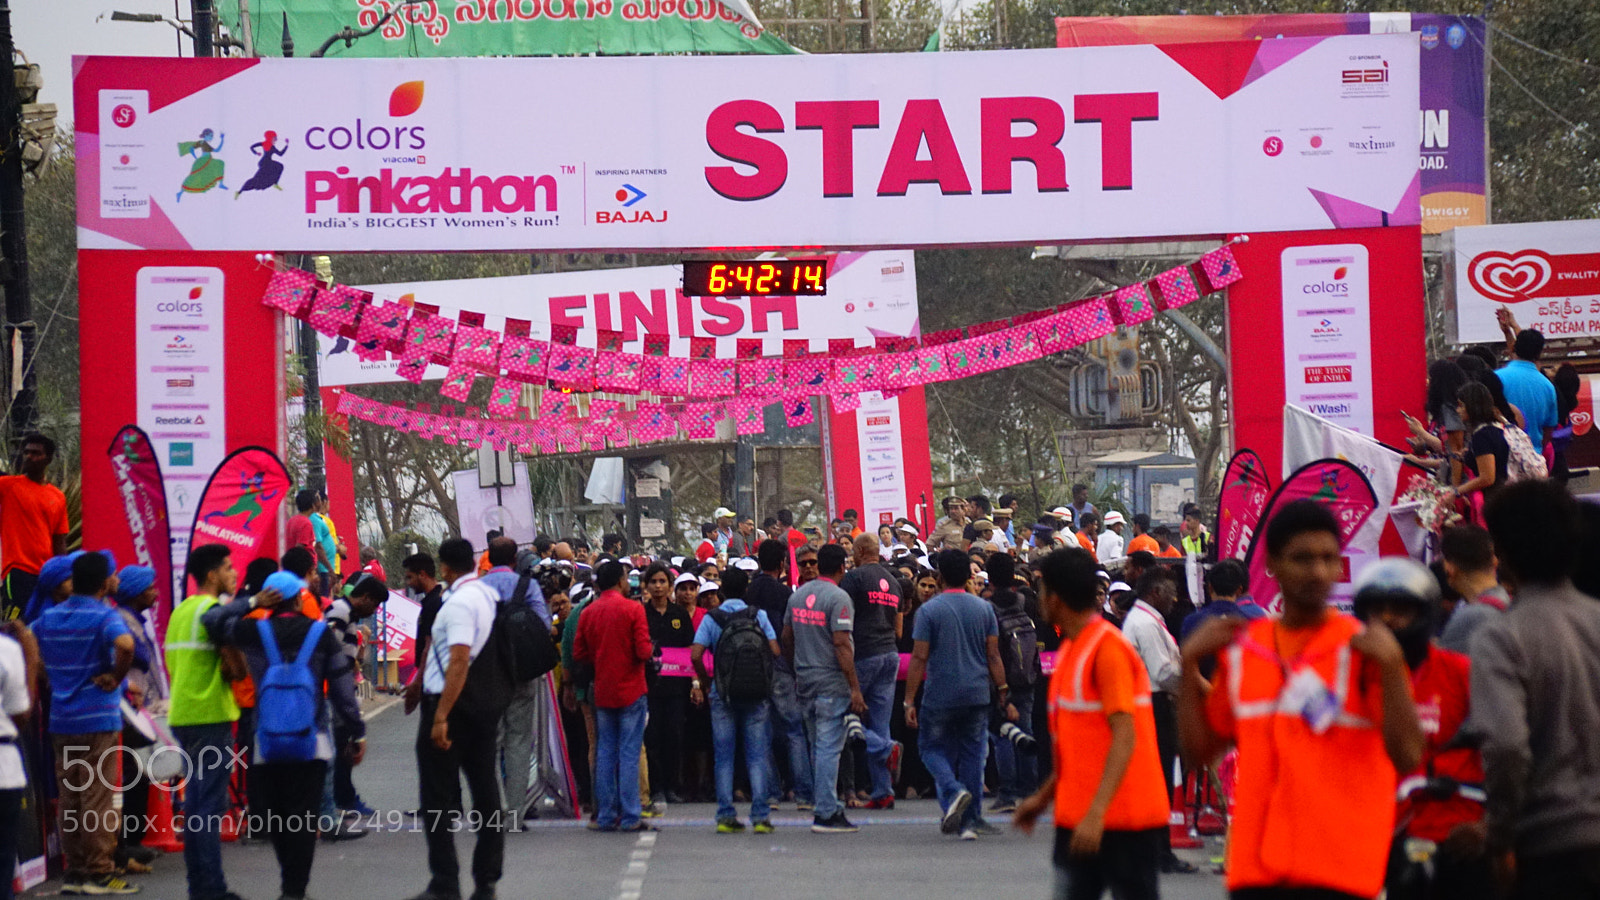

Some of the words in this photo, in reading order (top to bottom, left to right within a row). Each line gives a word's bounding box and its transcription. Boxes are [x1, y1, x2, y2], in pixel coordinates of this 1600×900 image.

[305, 118, 426, 151] colors
[704, 92, 1160, 201] START
[305, 166, 557, 214] Pinkathon
[596, 211, 668, 224] BAJAJ
[1425, 207, 1470, 217] SWIGGY
[307, 217, 359, 229] India's
[366, 217, 437, 228] BIGGEST
[445, 216, 517, 227] Women's
[524, 215, 559, 227] Run!
[708, 264, 823, 294] 6:42:14
[1558, 270, 1599, 280] KWALITY
[1303, 281, 1349, 294] colors
[157, 300, 203, 312] colors
[548, 287, 799, 342] FINISH
[1549, 320, 1585, 334] CREAM
[155, 416, 192, 425] Reebok
